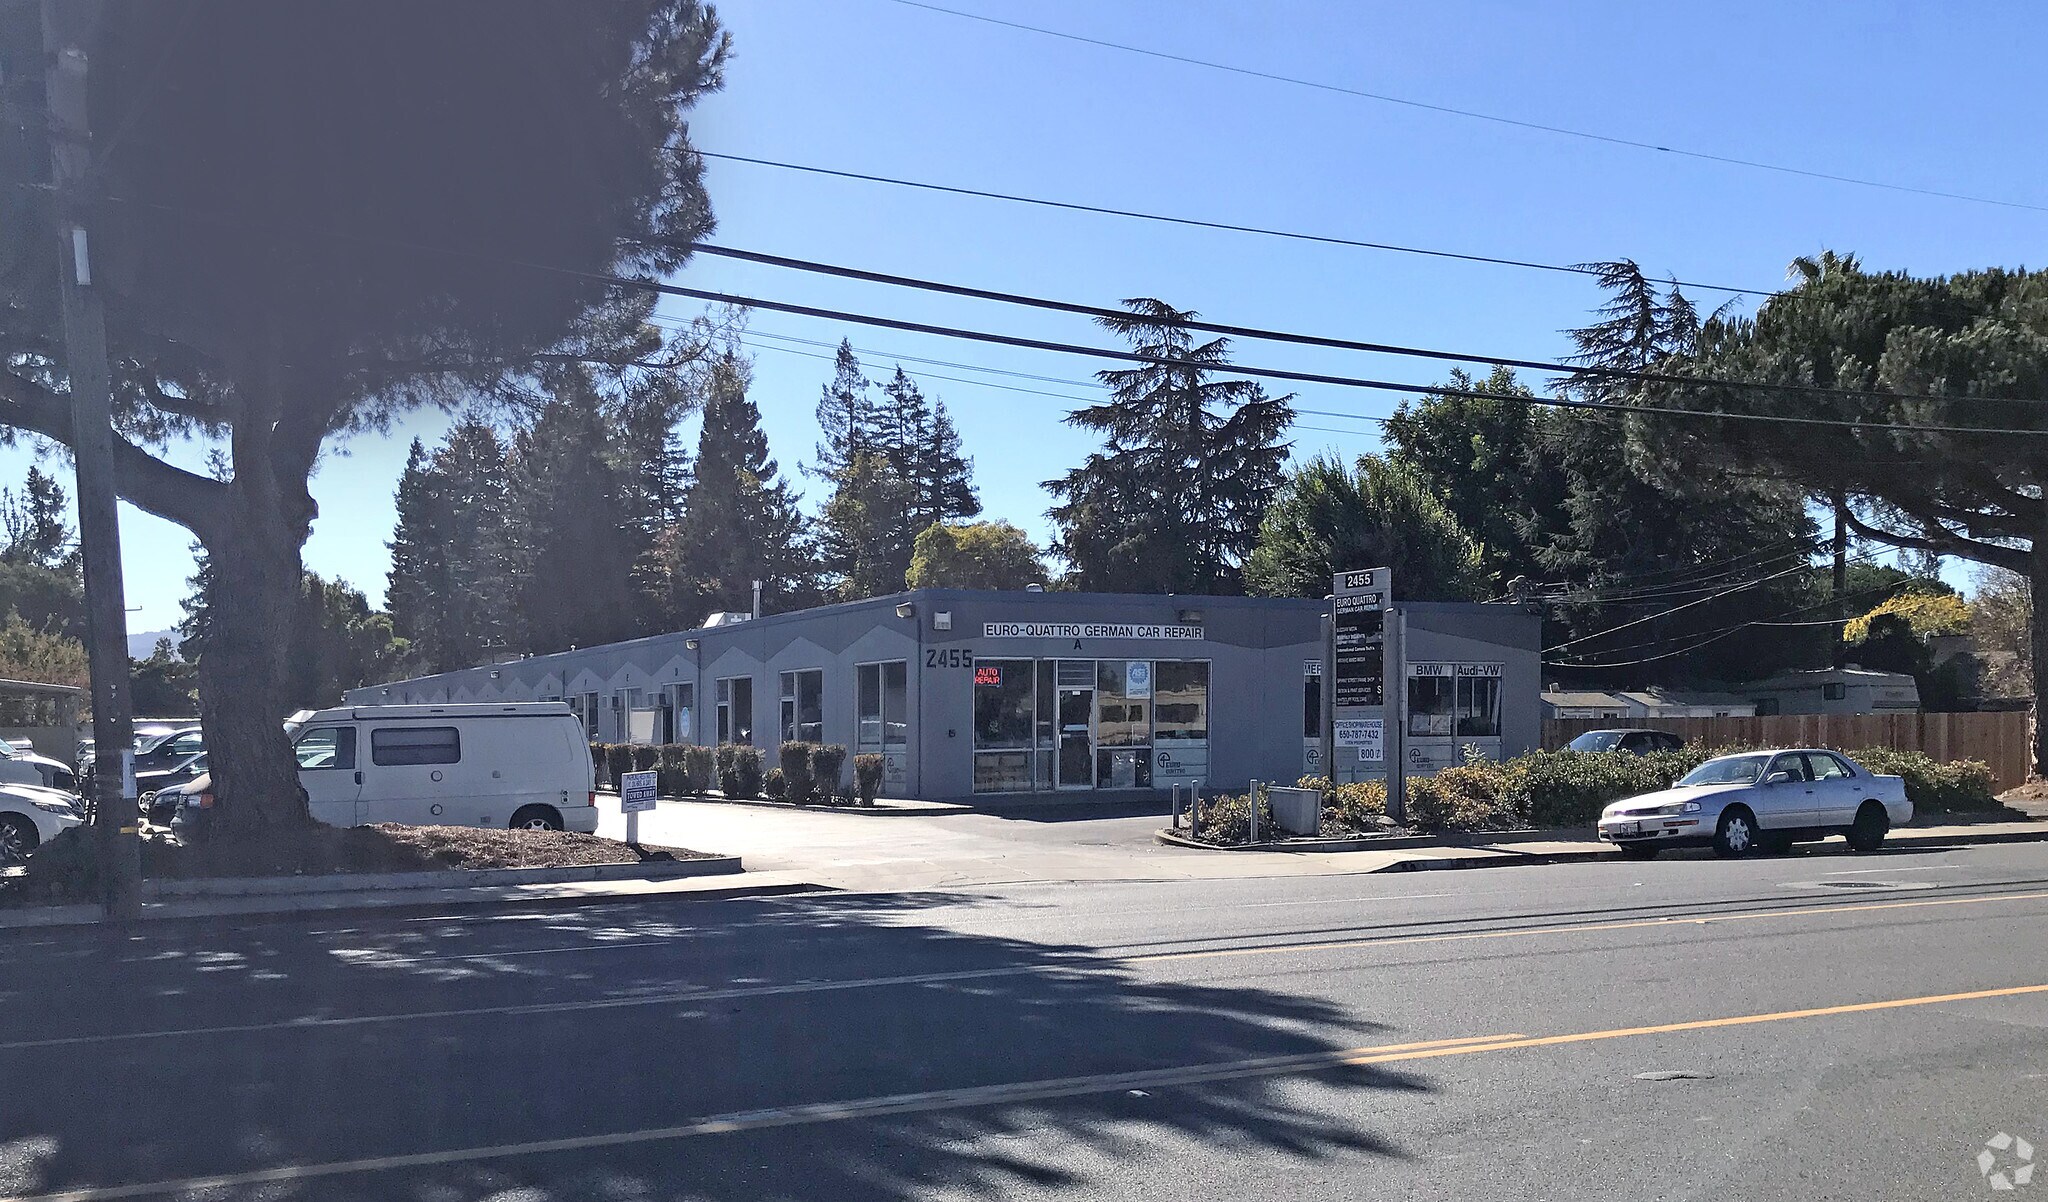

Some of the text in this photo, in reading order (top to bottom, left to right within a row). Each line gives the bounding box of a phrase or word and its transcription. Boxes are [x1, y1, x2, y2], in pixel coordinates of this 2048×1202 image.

[1347, 573, 1371, 587] 2455
[1336, 594, 1377, 608] EURO QUATTRO
[1336, 606, 1354, 614] GERMAN
[1354, 605, 1363, 613] CAR
[986, 624, 1202, 638] EURO-QUATTRO GERMAN CAR REPAIR
[1073, 639, 1082, 650] A
[926, 650, 973, 668] 2455
[977, 668, 998, 676] AUTO
[1416, 666, 1442, 675] BMW
[1457, 665, 1499, 676] Audi-VW
[974, 675, 1000, 685] REPAIR
[1376, 685, 1382, 694] S
[1339, 730, 1379, 739] 650-787-7432
[1361, 749, 1375, 759] 800
[627, 790, 643, 800] TOWED
